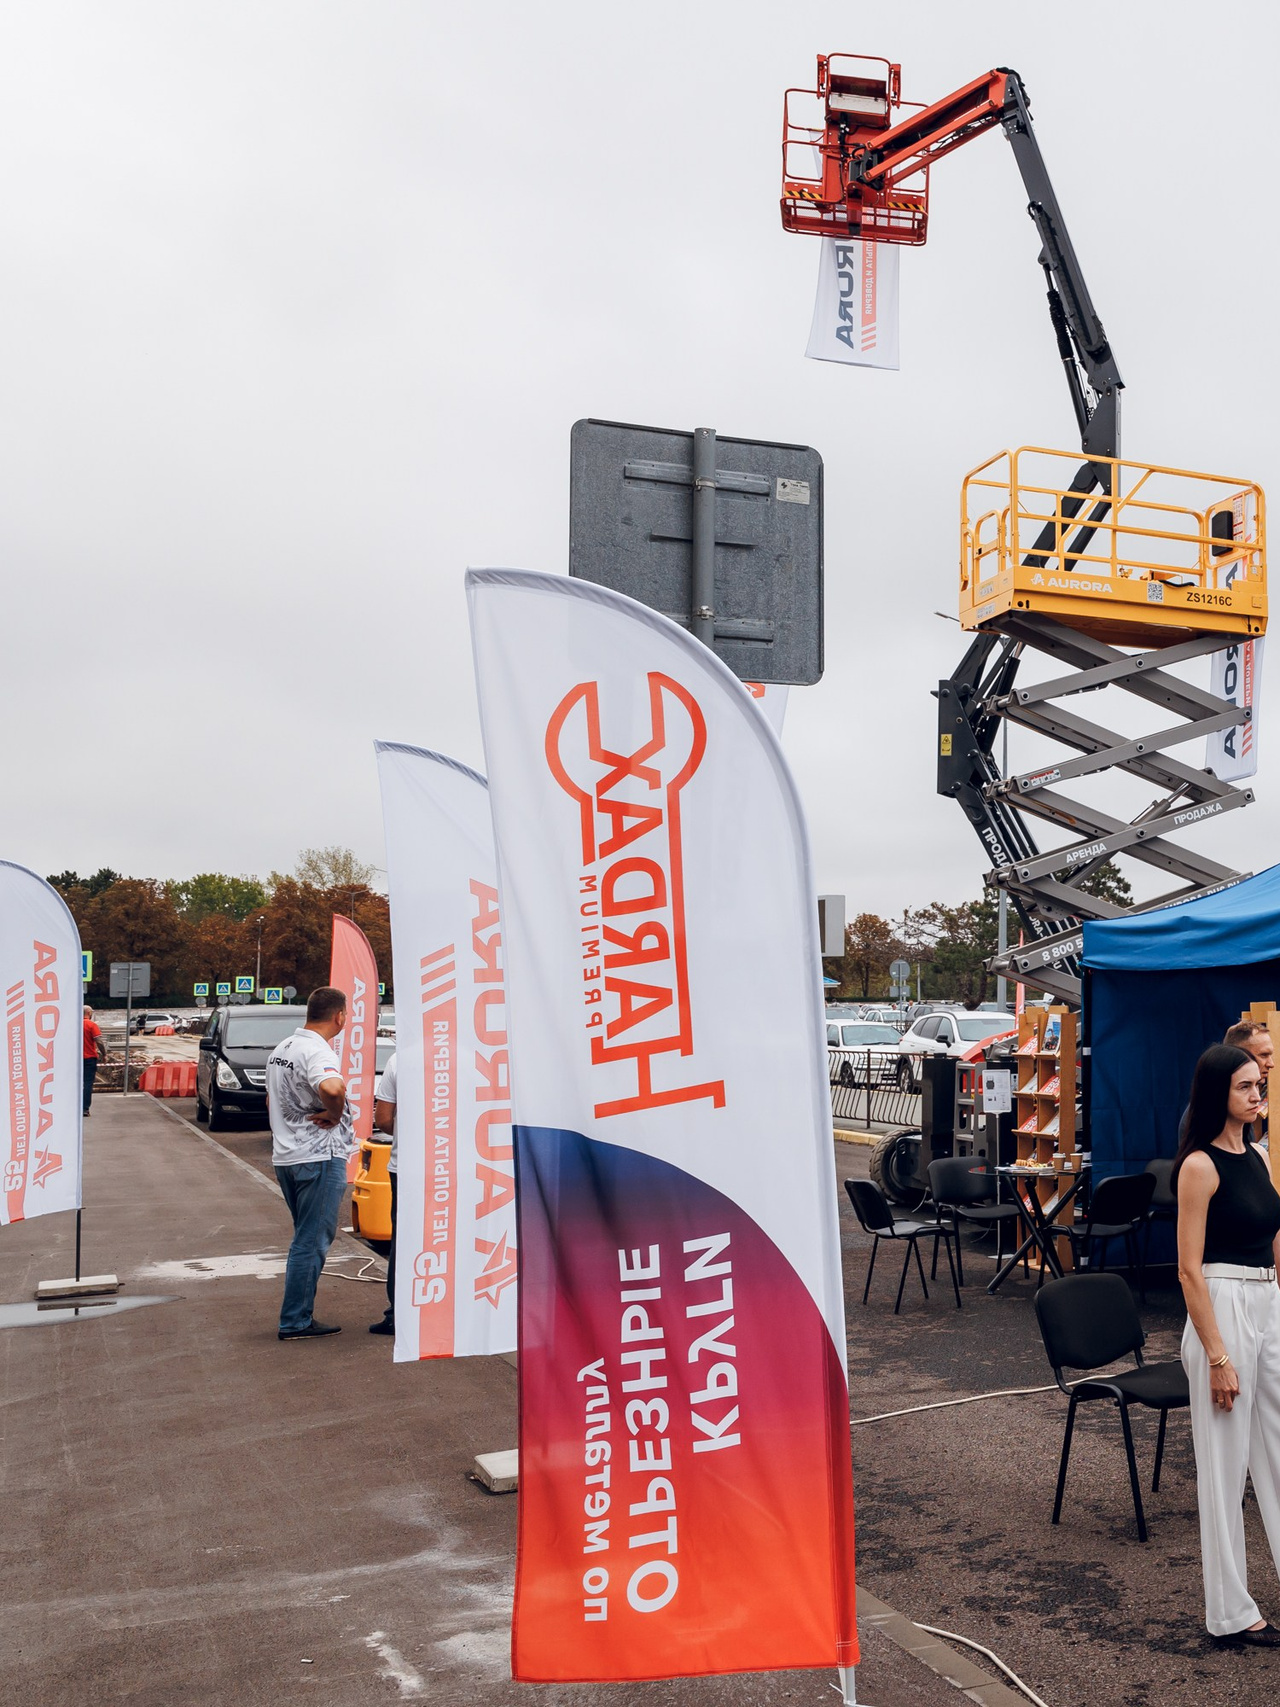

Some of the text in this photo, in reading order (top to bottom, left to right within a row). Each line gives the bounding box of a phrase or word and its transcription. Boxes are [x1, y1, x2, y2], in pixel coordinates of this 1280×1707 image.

[1048, 578, 1113, 592] AURORA
[1187, 592, 1232, 606] ZS1216C
[1174, 803, 1223, 825] ПРОДАЖА
[1066, 843, 1107, 863] АРЕНДА
[1042, 951, 1051, 961] 8
[1051, 942, 1074, 958] 800
